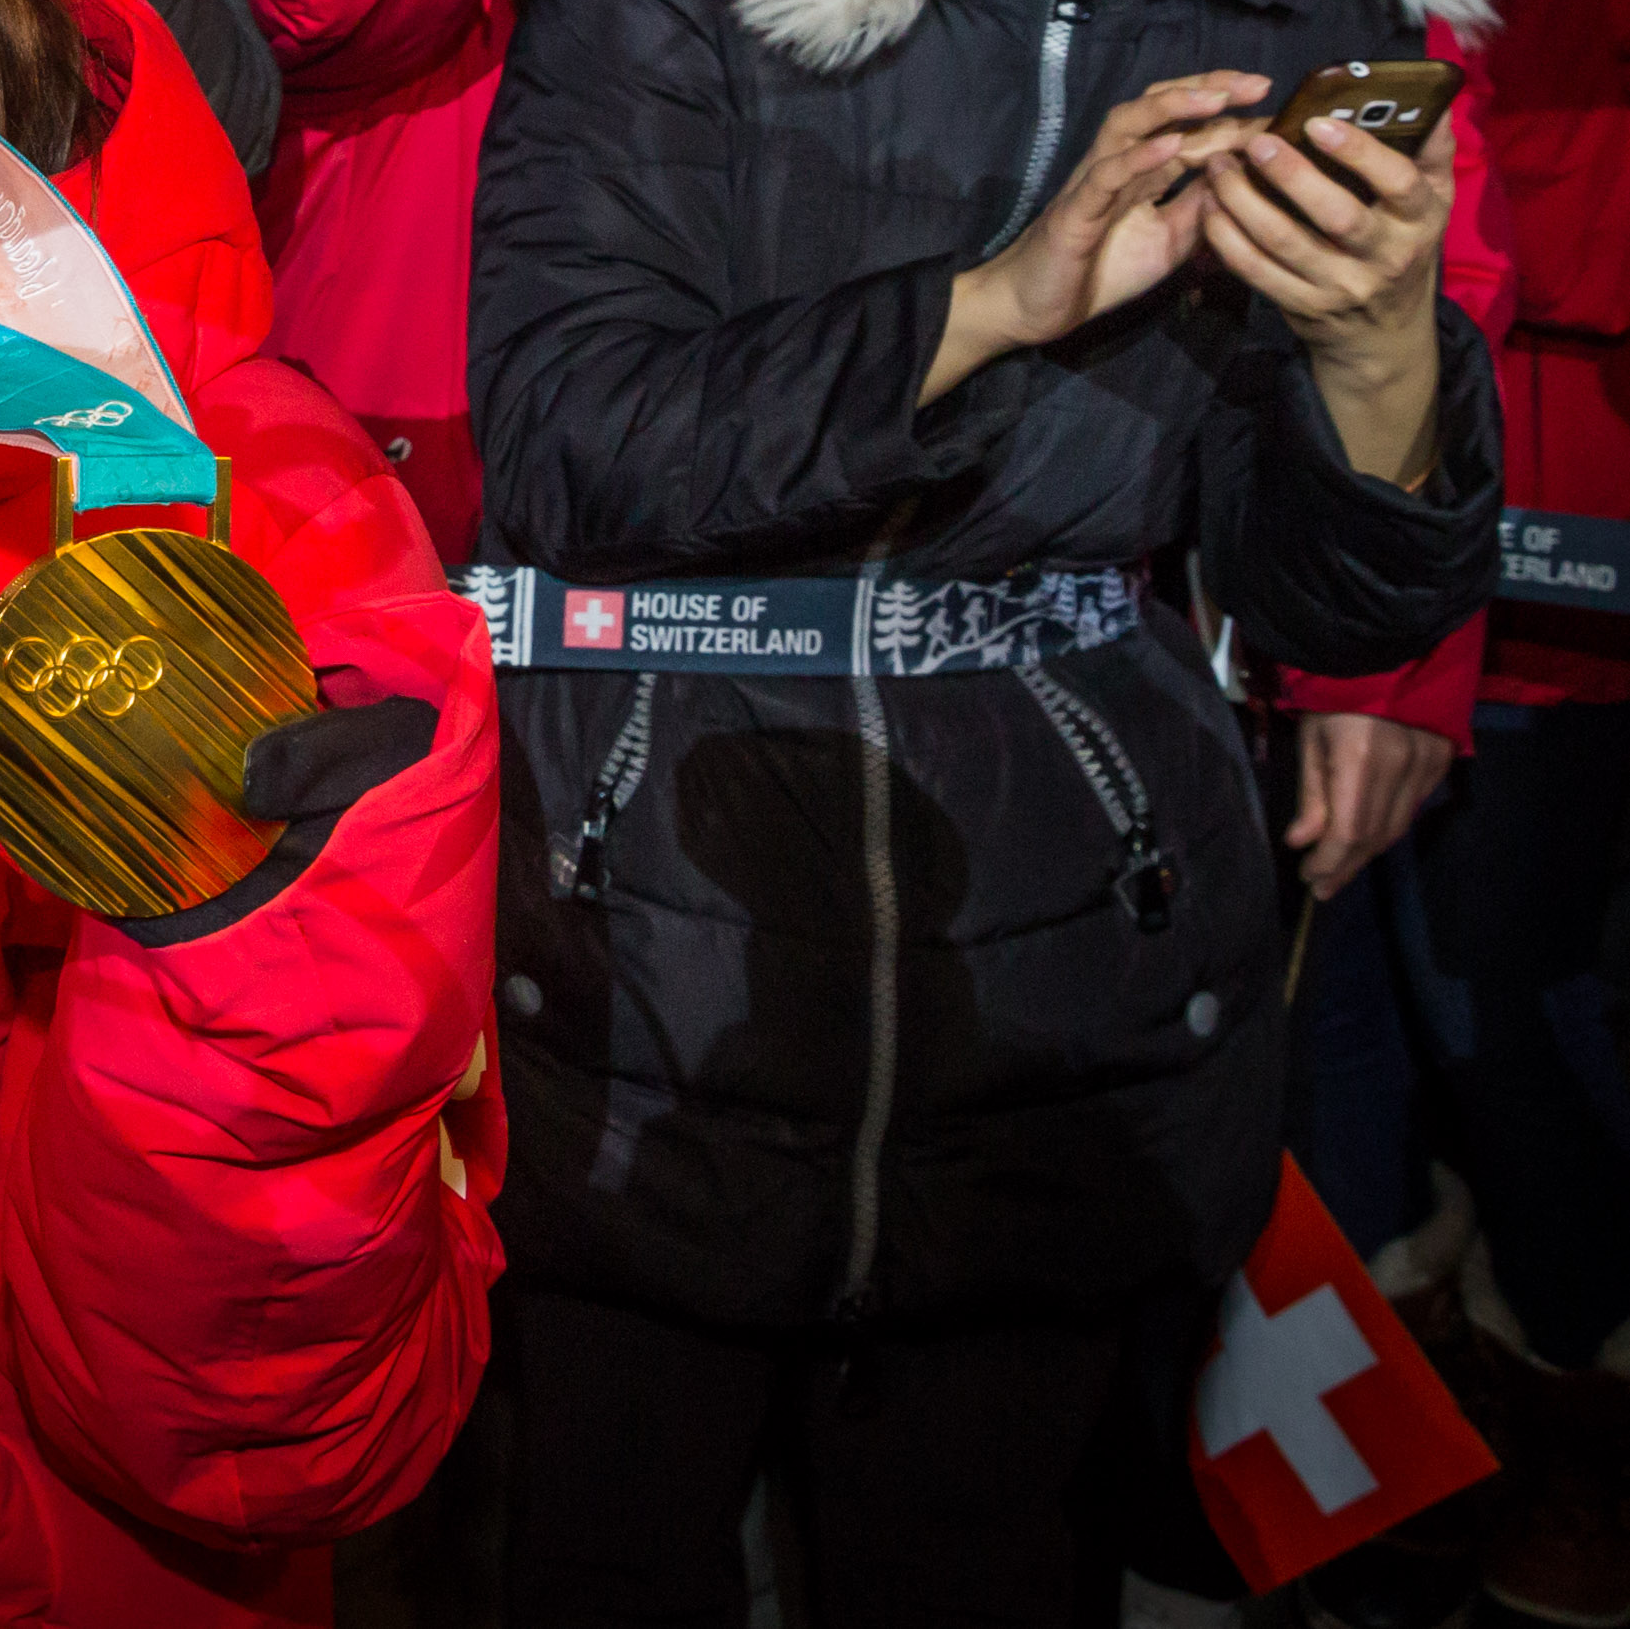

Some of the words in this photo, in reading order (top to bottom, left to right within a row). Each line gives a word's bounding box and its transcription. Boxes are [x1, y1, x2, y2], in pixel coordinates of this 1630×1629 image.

[1523, 525, 1561, 553] OF
[1501, 553, 1617, 592] ERLAND
[631, 592, 723, 621] HOUSE
[731, 595, 768, 622] OF
[630, 624, 823, 656] SWITZERLAND
